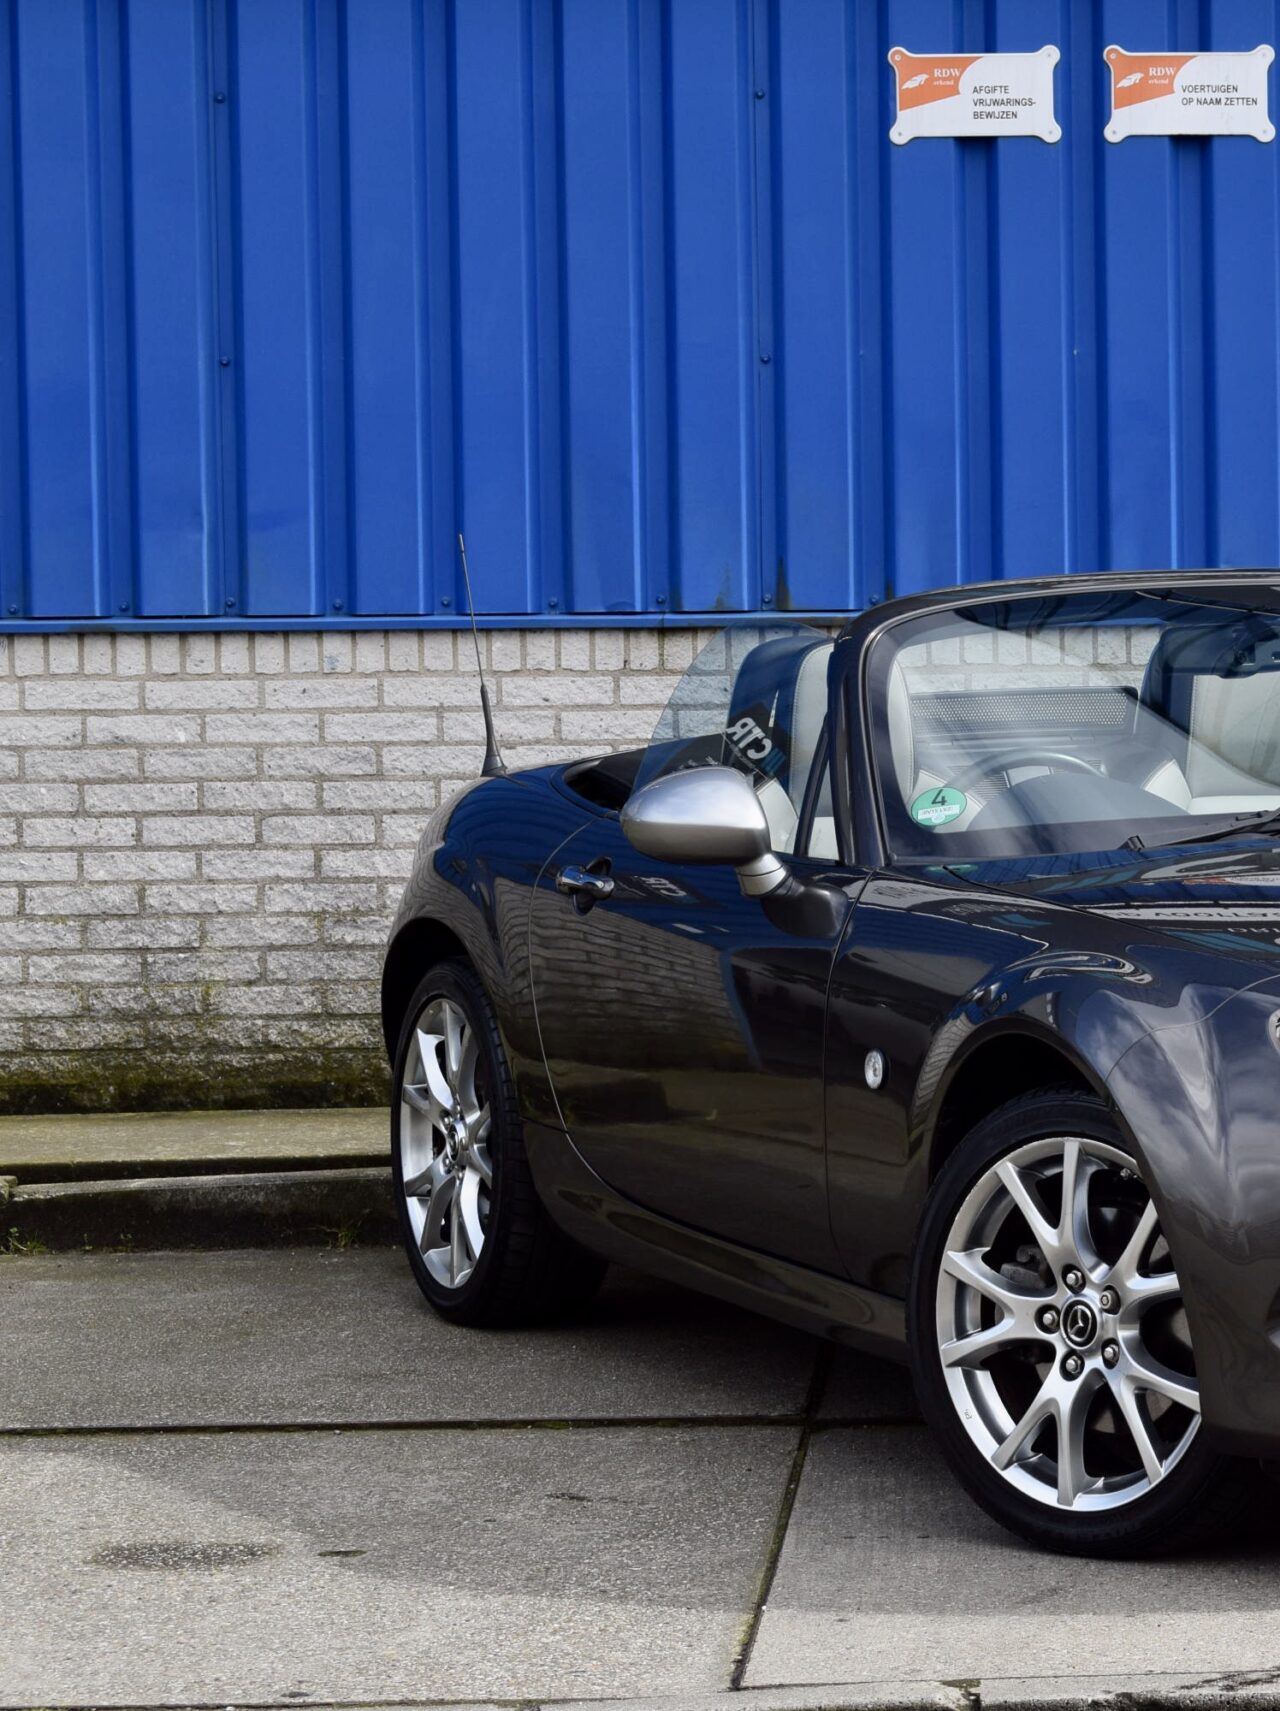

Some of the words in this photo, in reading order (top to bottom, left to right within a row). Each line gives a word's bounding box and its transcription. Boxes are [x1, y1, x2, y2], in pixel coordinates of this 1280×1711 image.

[934, 68, 961, 78] RDW
[1149, 66, 1176, 76] RDW
[1148, 77, 1169, 85] erkend
[972, 85, 1009, 94] AFGIFTE
[1181, 84, 1238, 94] VOERTUIGEN
[972, 97, 1036, 107] VRIJWARINGS-
[1181, 97, 1194, 106] OP
[1196, 97, 1221, 106] NAAM
[1224, 97, 1258, 106] ZETTEN
[973, 110, 1017, 120] BEWIJZEN
[931, 788, 947, 806] 4
